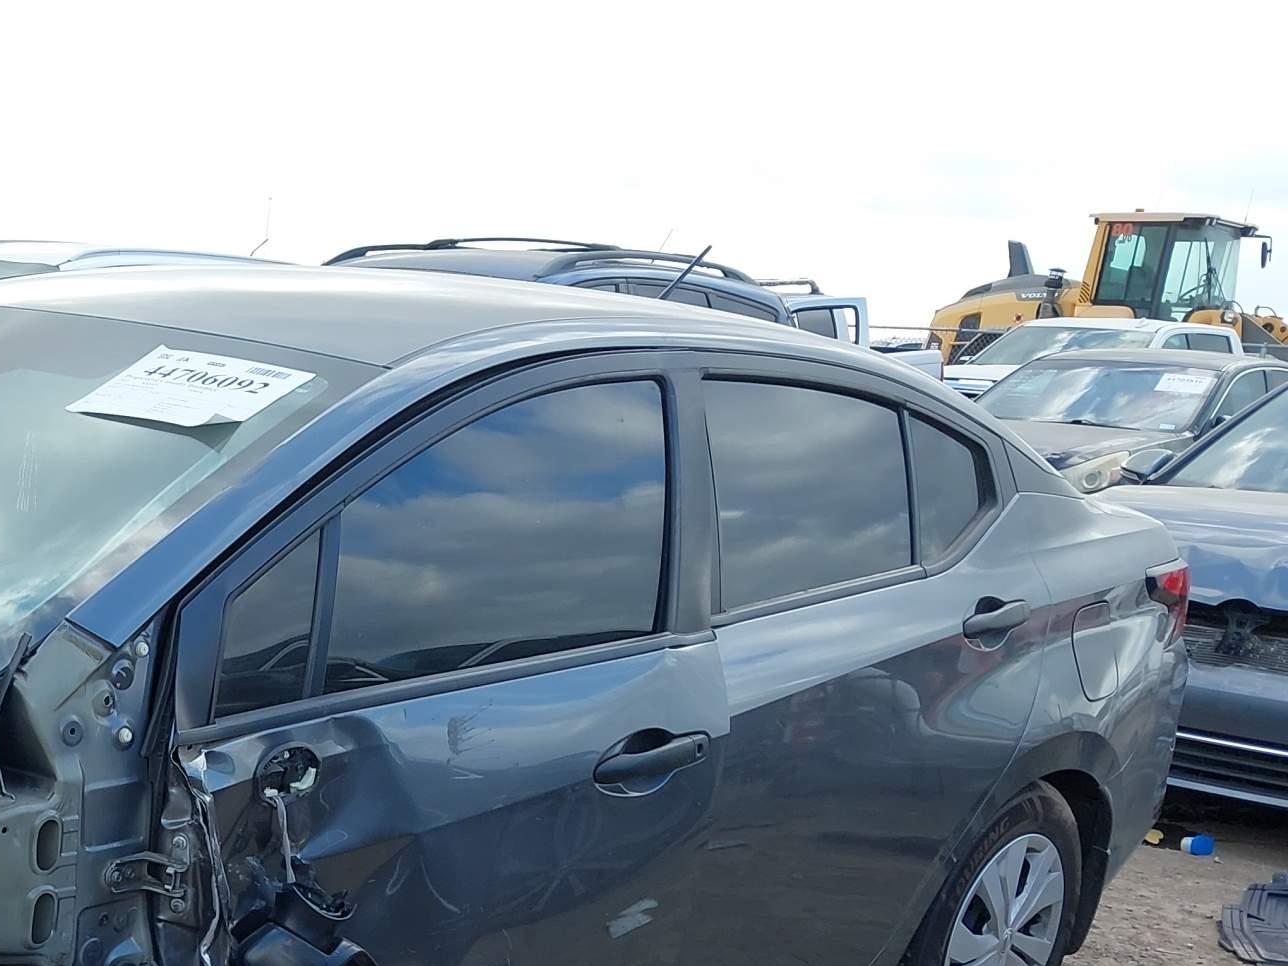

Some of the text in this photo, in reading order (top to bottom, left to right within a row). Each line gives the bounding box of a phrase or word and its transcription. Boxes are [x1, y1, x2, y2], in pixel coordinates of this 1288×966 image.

[1112, 223, 1133, 237] 80
[144, 365, 270, 394] 44706092
[952, 817, 1009, 905] OURING
